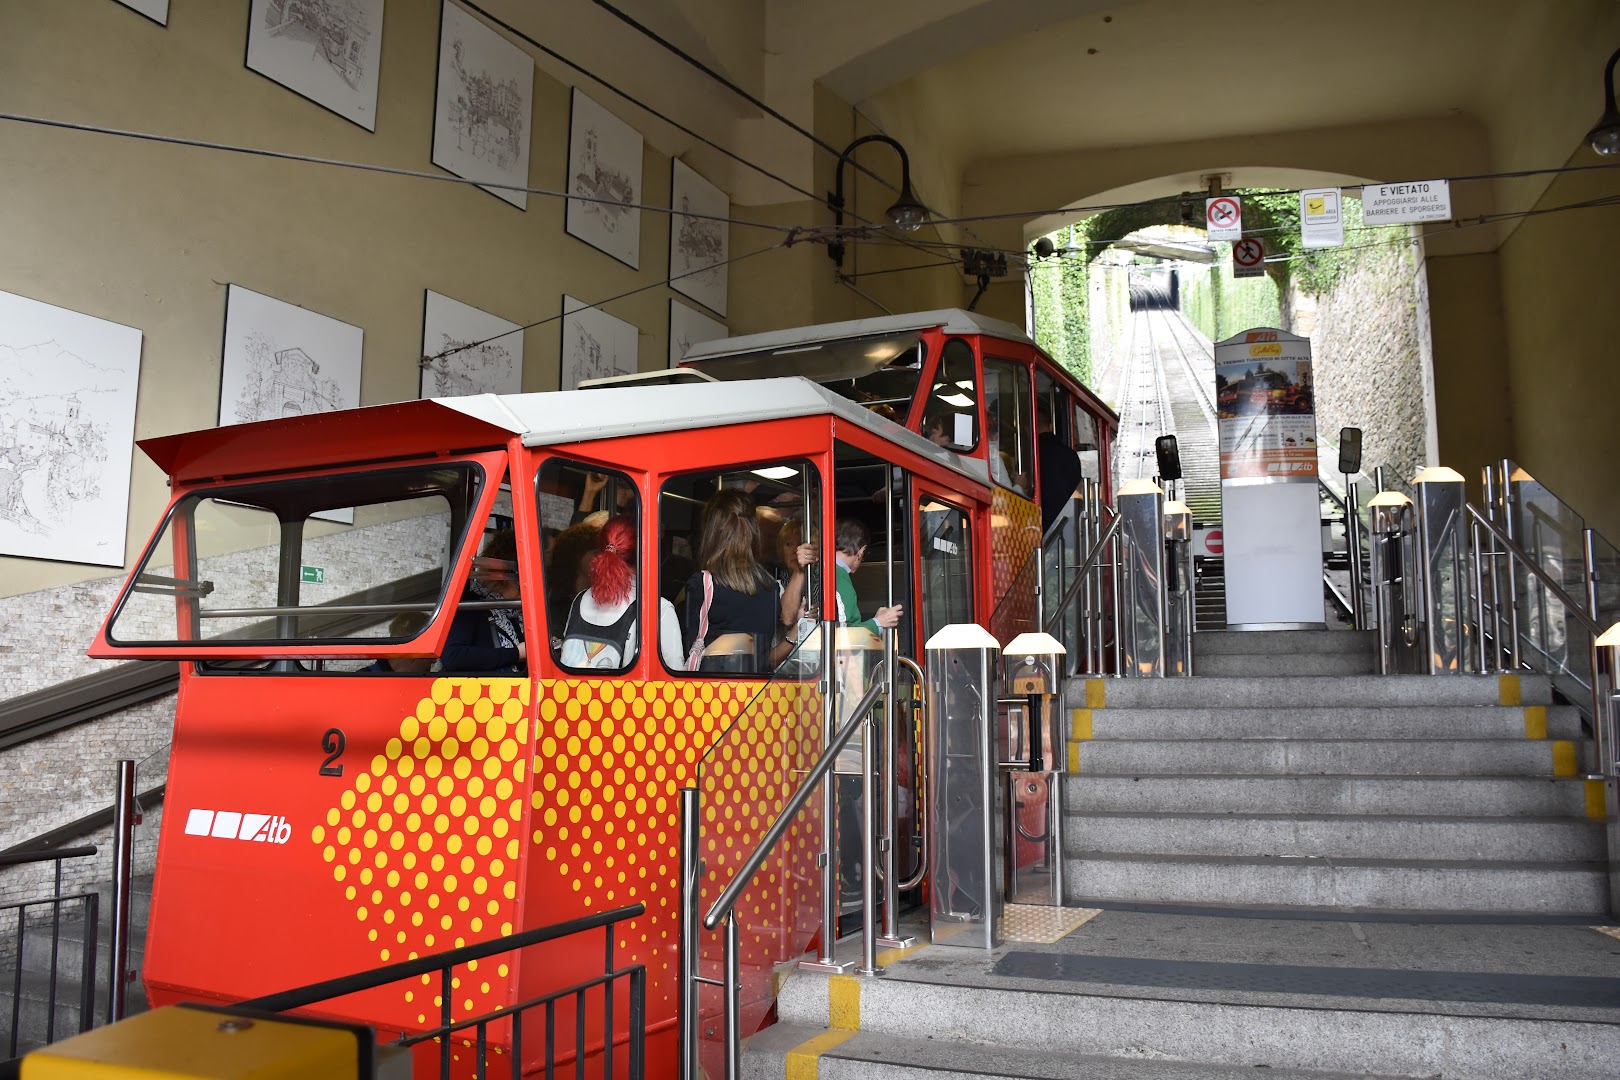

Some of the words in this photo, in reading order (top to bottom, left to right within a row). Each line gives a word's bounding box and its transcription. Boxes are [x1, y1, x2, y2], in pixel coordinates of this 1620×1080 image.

[1390, 184, 1430, 195] VIETATO
[1373, 196, 1418, 206] APPOGGIARSI
[1421, 195, 1438, 203] ALLE
[1366, 207, 1399, 216] BARRIERE
[1409, 204, 1446, 213] SPORGERSI
[319, 727, 347, 777] 2
